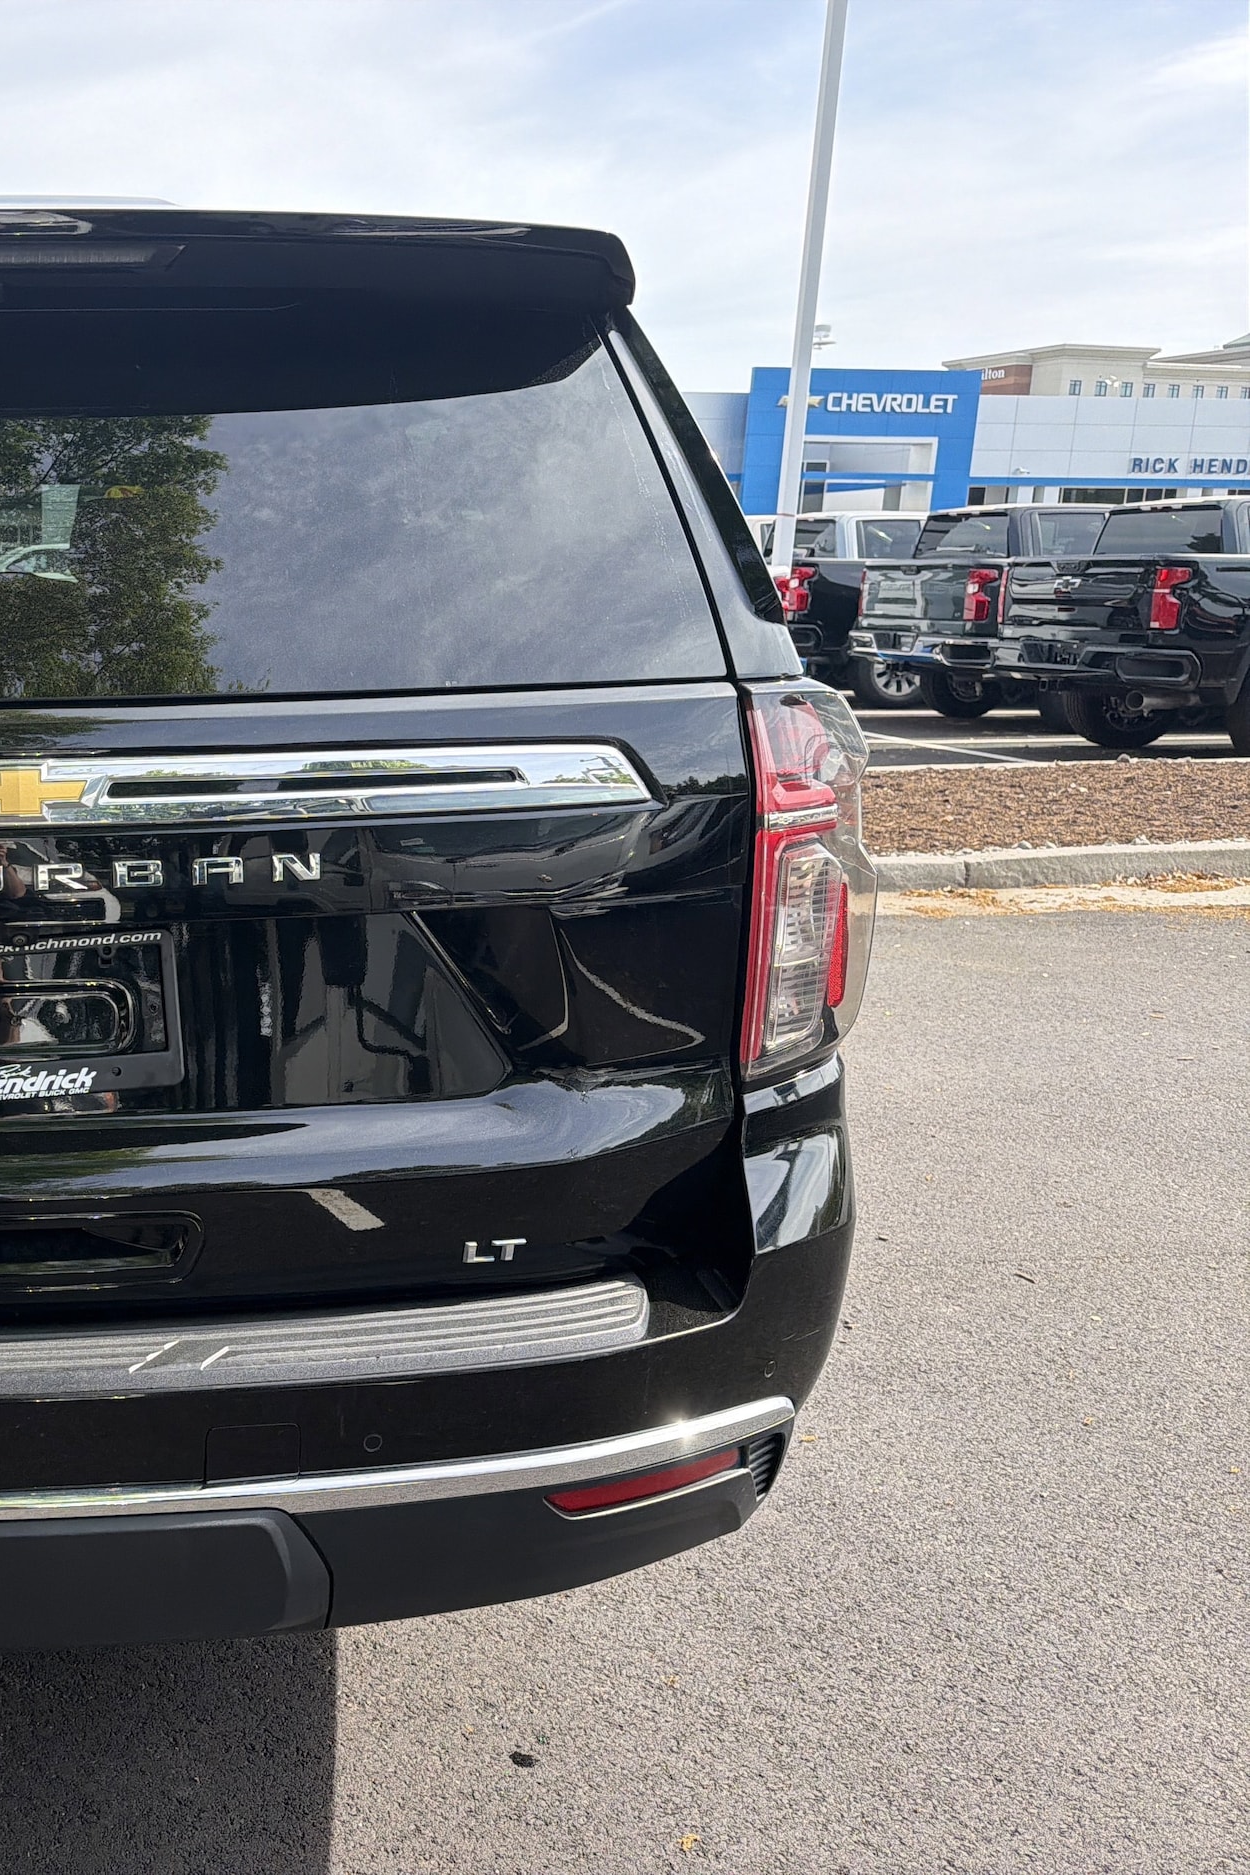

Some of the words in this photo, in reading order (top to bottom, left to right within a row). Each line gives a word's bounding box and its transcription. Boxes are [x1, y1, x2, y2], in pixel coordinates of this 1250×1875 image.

[826, 392, 958, 414] CHEVROLET
[1131, 457, 1179, 473] RICK
[1192, 458, 1248, 475] HEND
[38, 1089, 66, 1098] BUICK
[68, 1087, 90, 1095] GMC
[462, 1238, 527, 1263] LT
